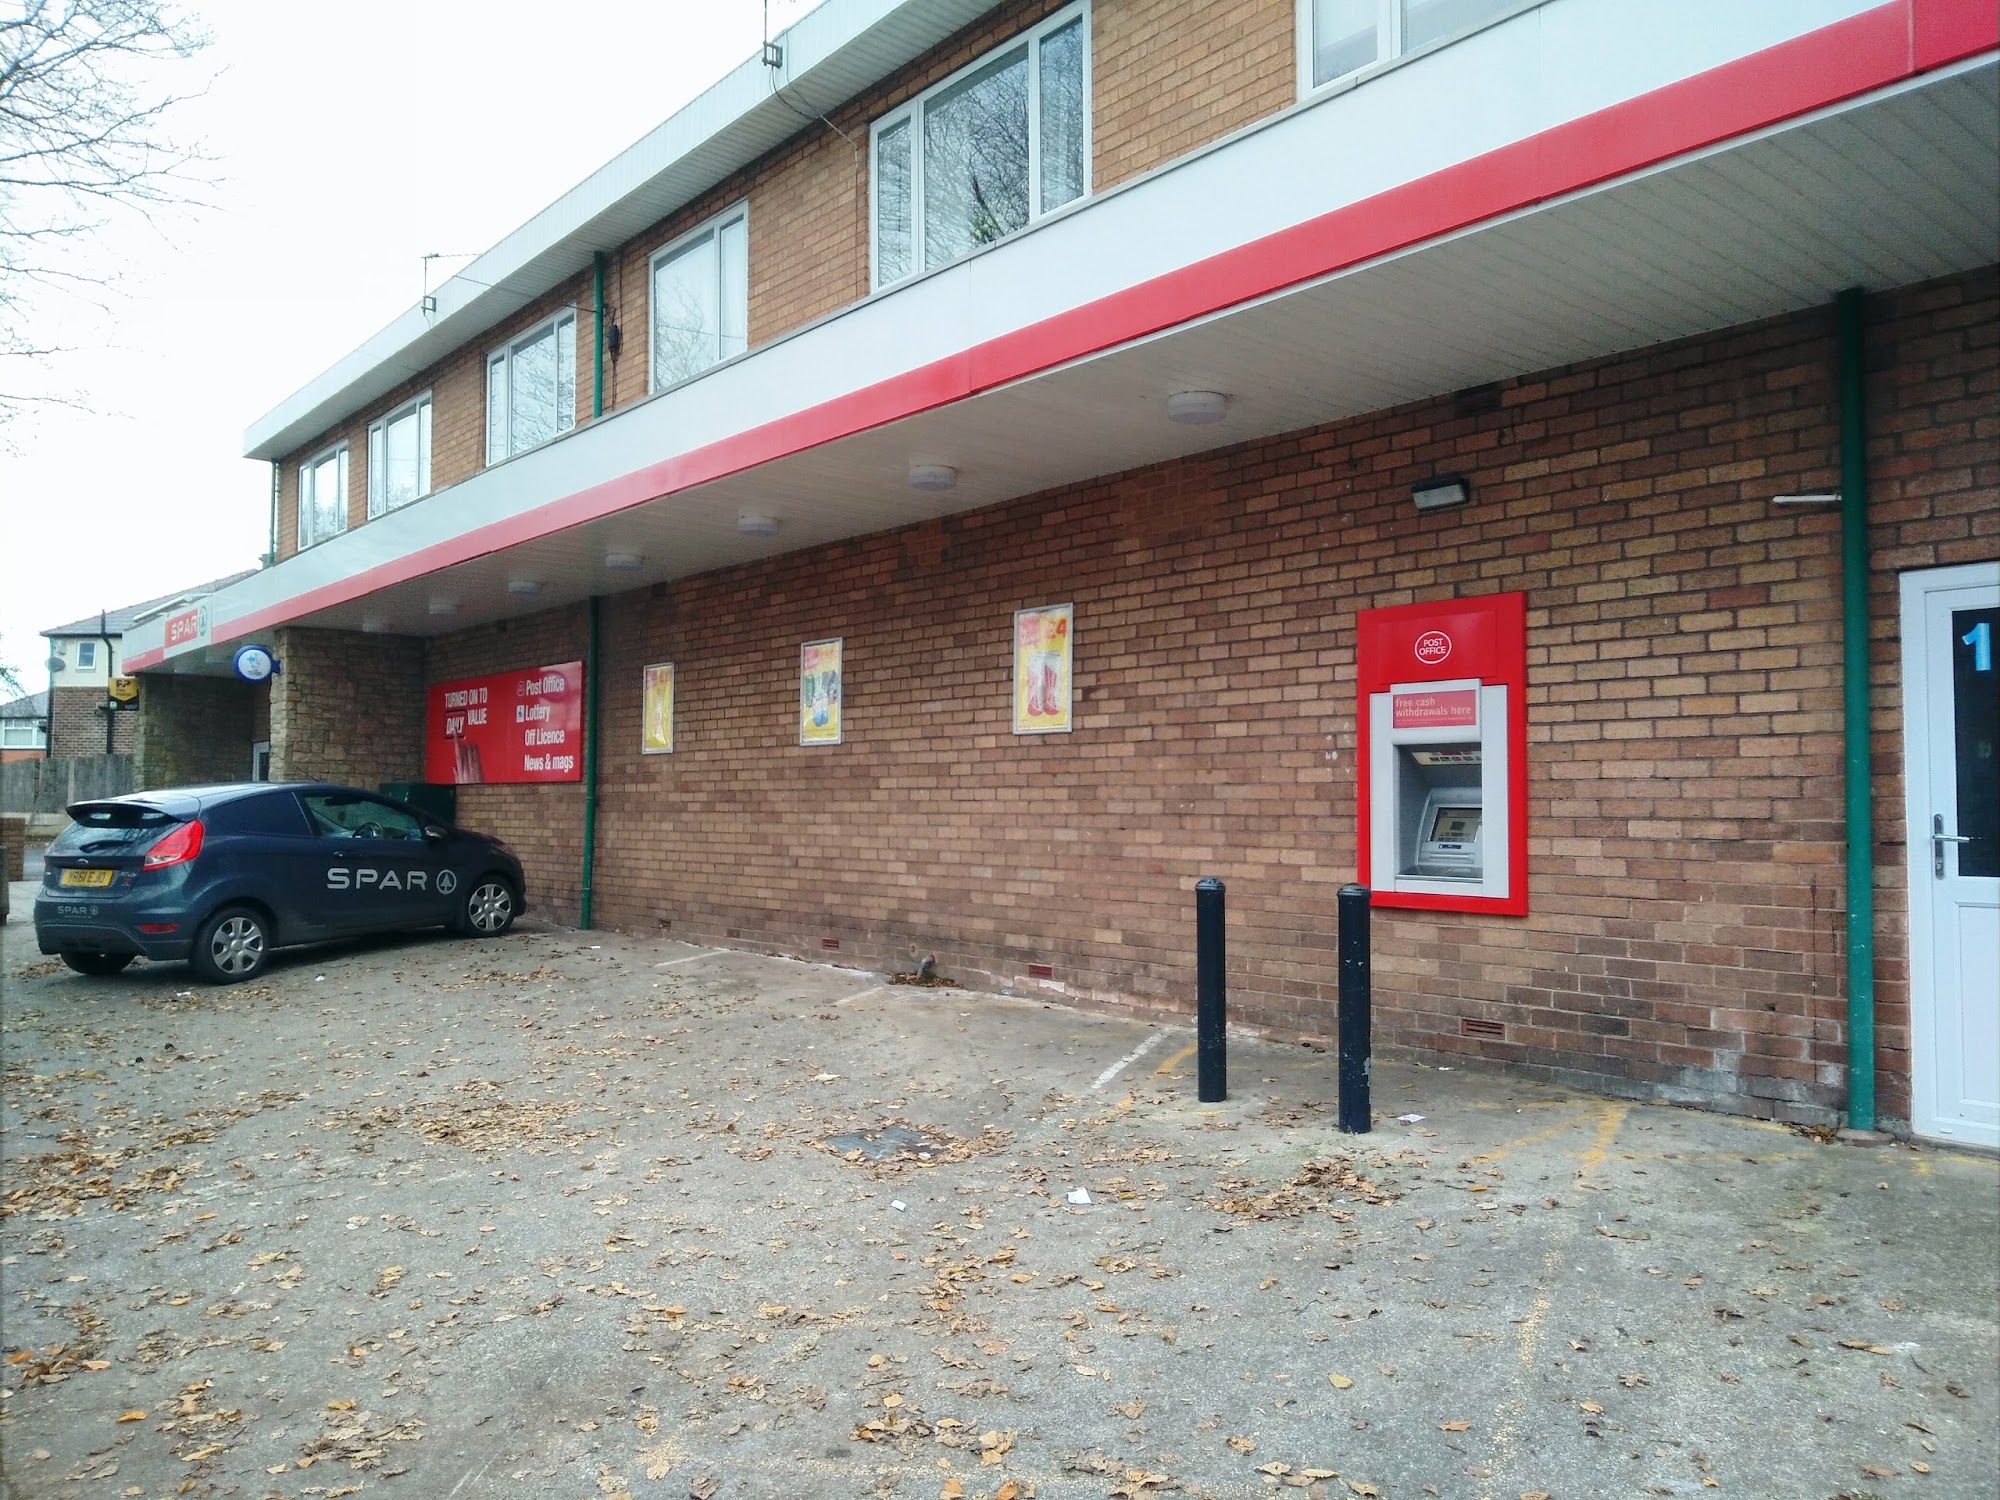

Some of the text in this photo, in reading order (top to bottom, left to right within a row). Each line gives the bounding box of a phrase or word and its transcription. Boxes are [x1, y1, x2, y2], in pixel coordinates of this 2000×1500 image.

[171, 615, 197, 641] SPAR
[1419, 646, 1446, 656] OFFICE
[1423, 638, 1443, 647] POST
[1962, 622, 1991, 671] 1
[526, 679, 542, 696] Post
[543, 677, 564, 693] Office
[445, 687, 488, 708] TURNED ON TO
[1396, 697, 1435, 707] free cash
[468, 708, 487, 725] VALUE
[526, 704, 551, 722] Lottery
[1396, 705, 1471, 717] withdrawals here
[525, 729, 564, 746] Off Licence
[524, 753, 574, 773] News & mags
[326, 867, 428, 891] SPAR
[57, 905, 87, 915] SPAR
